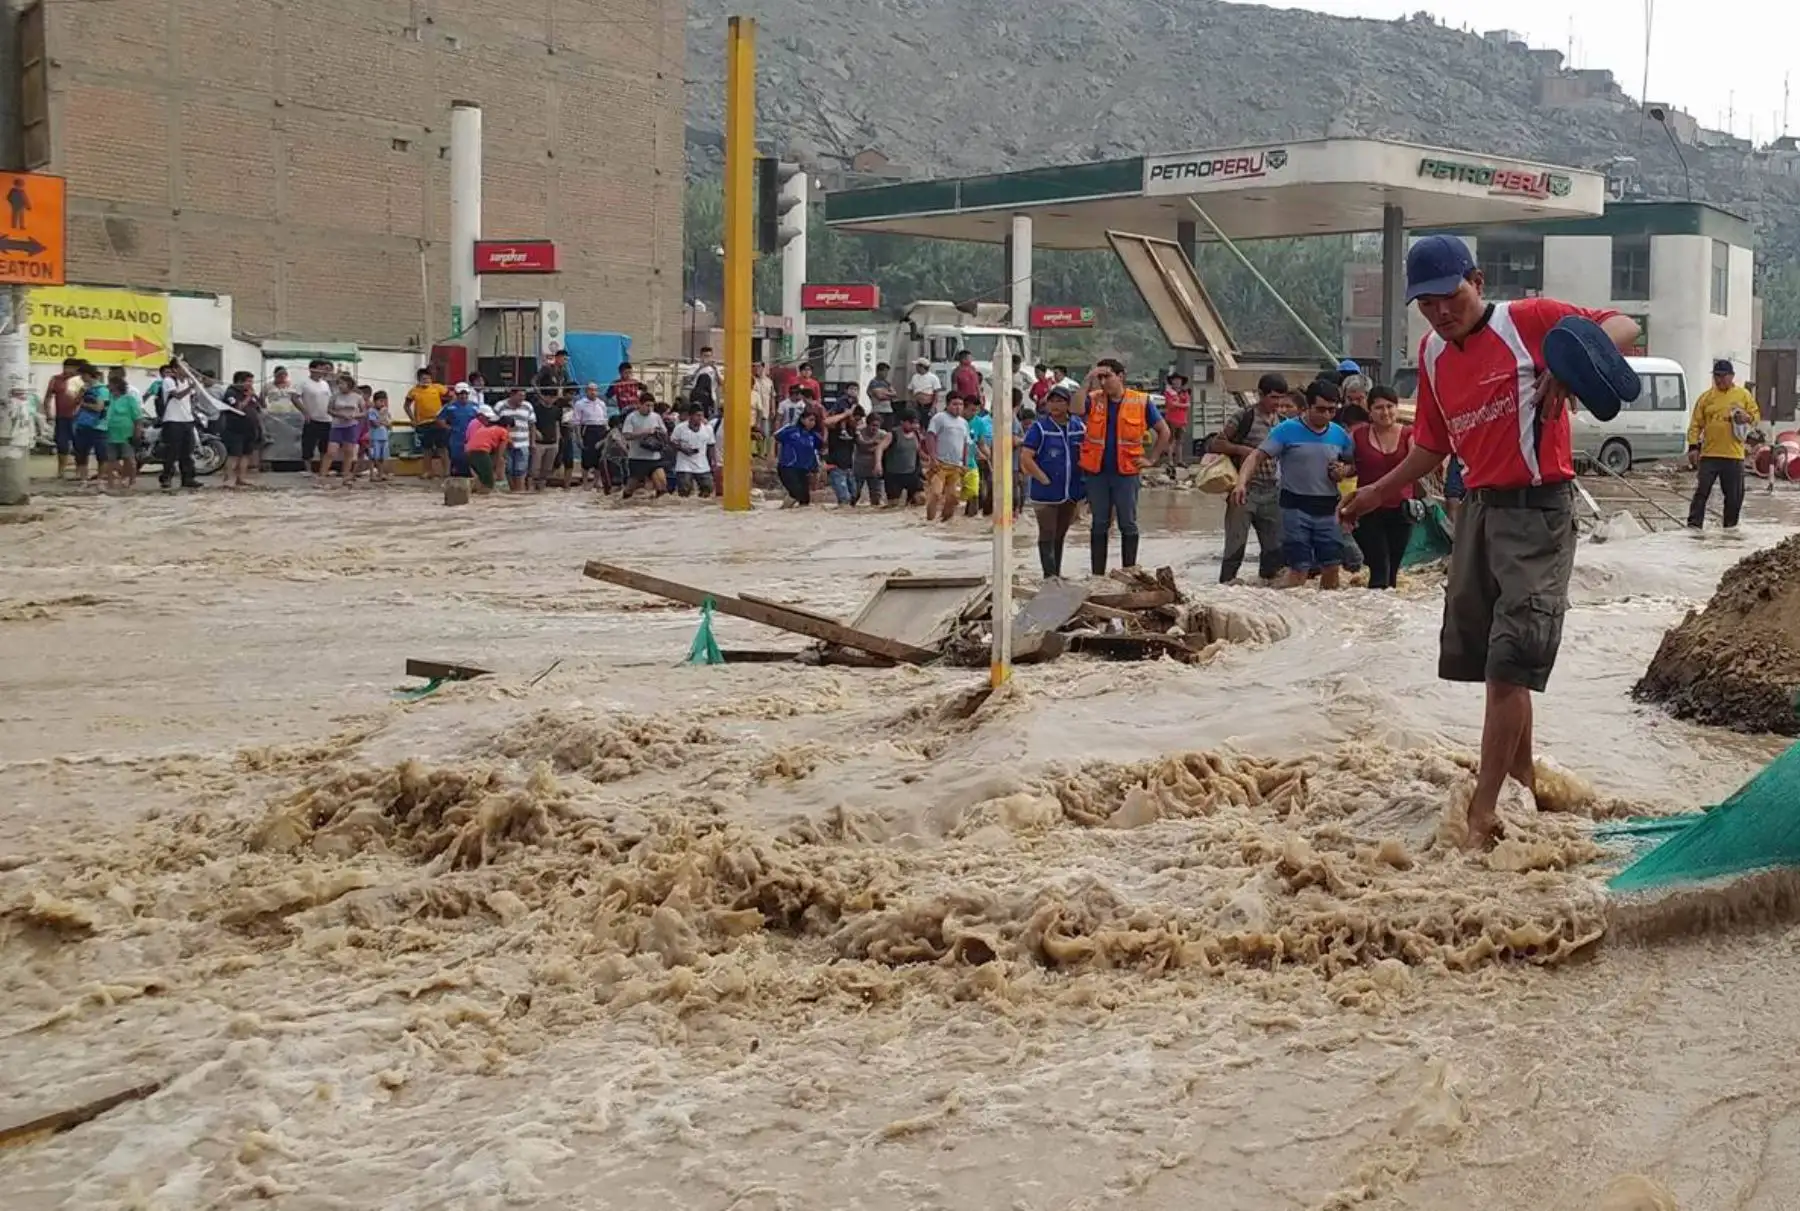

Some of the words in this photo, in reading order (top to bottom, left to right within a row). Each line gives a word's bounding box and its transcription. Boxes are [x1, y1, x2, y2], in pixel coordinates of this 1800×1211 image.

[1151, 152, 1264, 180] PETROPERU
[1417, 158, 1550, 193] PETROPERU
[40, 303, 162, 325] TRABAJANDO
